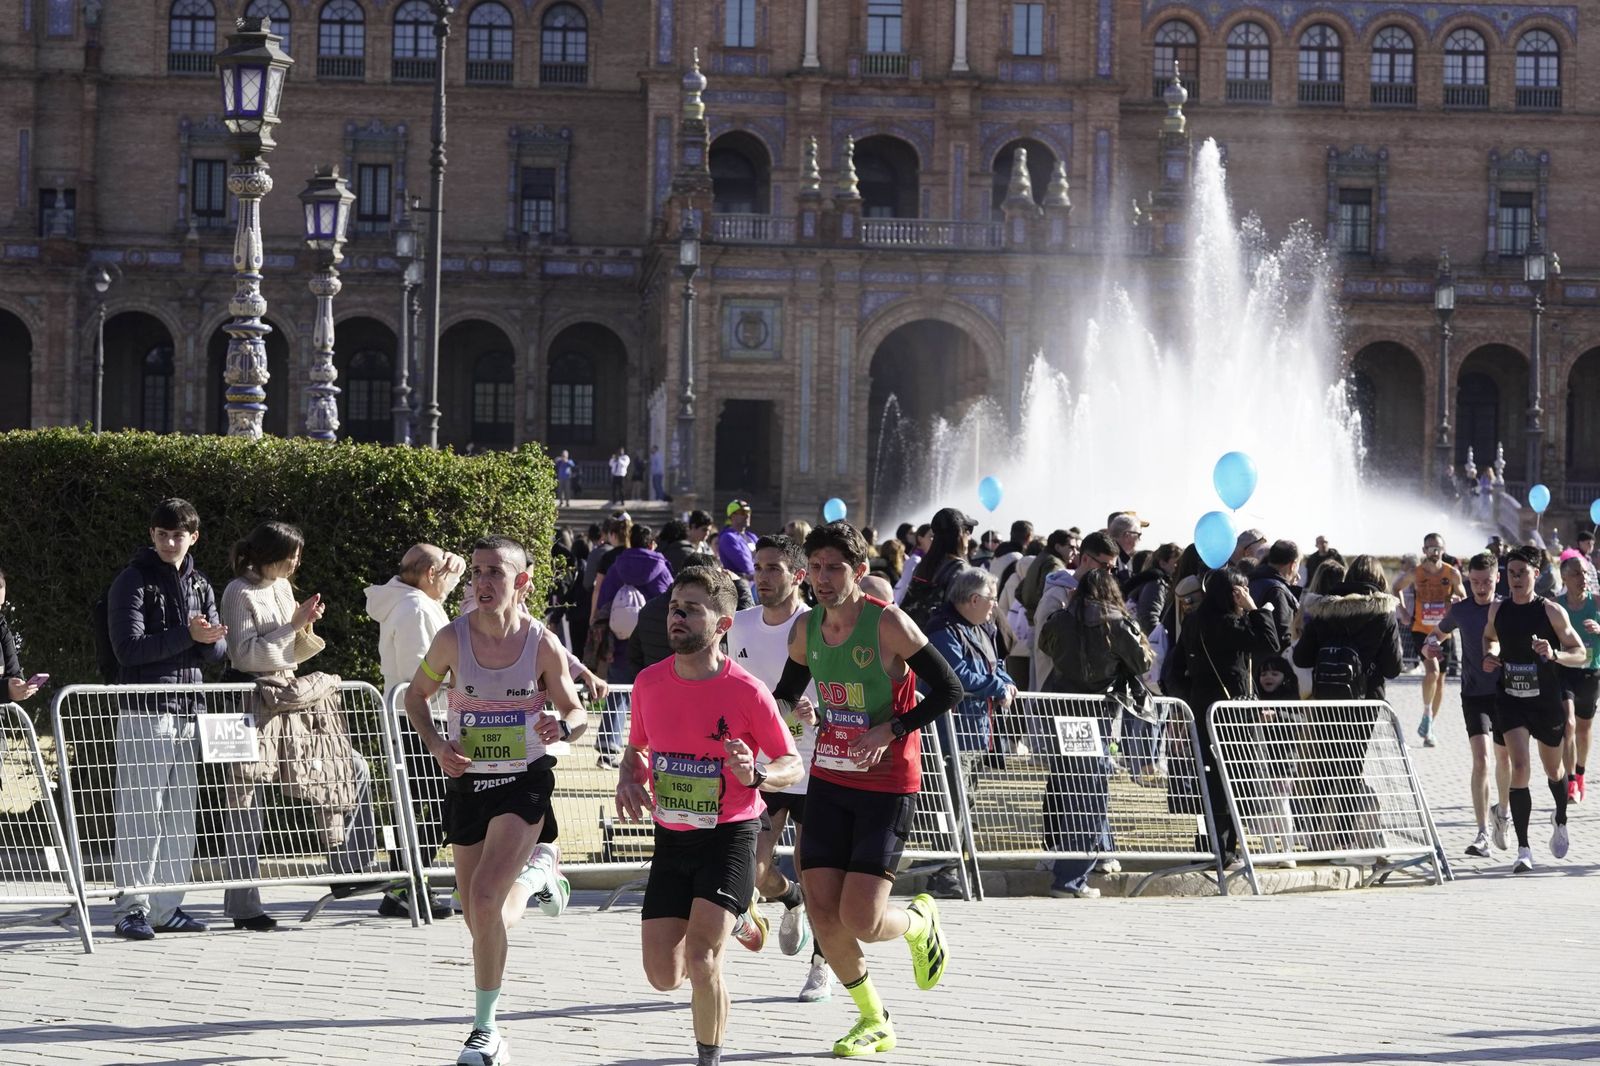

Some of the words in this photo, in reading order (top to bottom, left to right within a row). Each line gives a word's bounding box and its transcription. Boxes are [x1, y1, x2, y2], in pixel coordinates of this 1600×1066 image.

[818, 681, 866, 708] ADN
[480, 714, 518, 724] ZURICH
[834, 713, 862, 723] ZURICH
[214, 720, 245, 740] AMS
[835, 731, 848, 740] 953
[1066, 722, 1089, 738] AMS
[482, 733, 502, 742] 1887
[473, 746, 511, 759] AITOR
[816, 743, 840, 755] LUCAS
[671, 761, 711, 774] ZURICH
[671, 782, 693, 793] 1630
